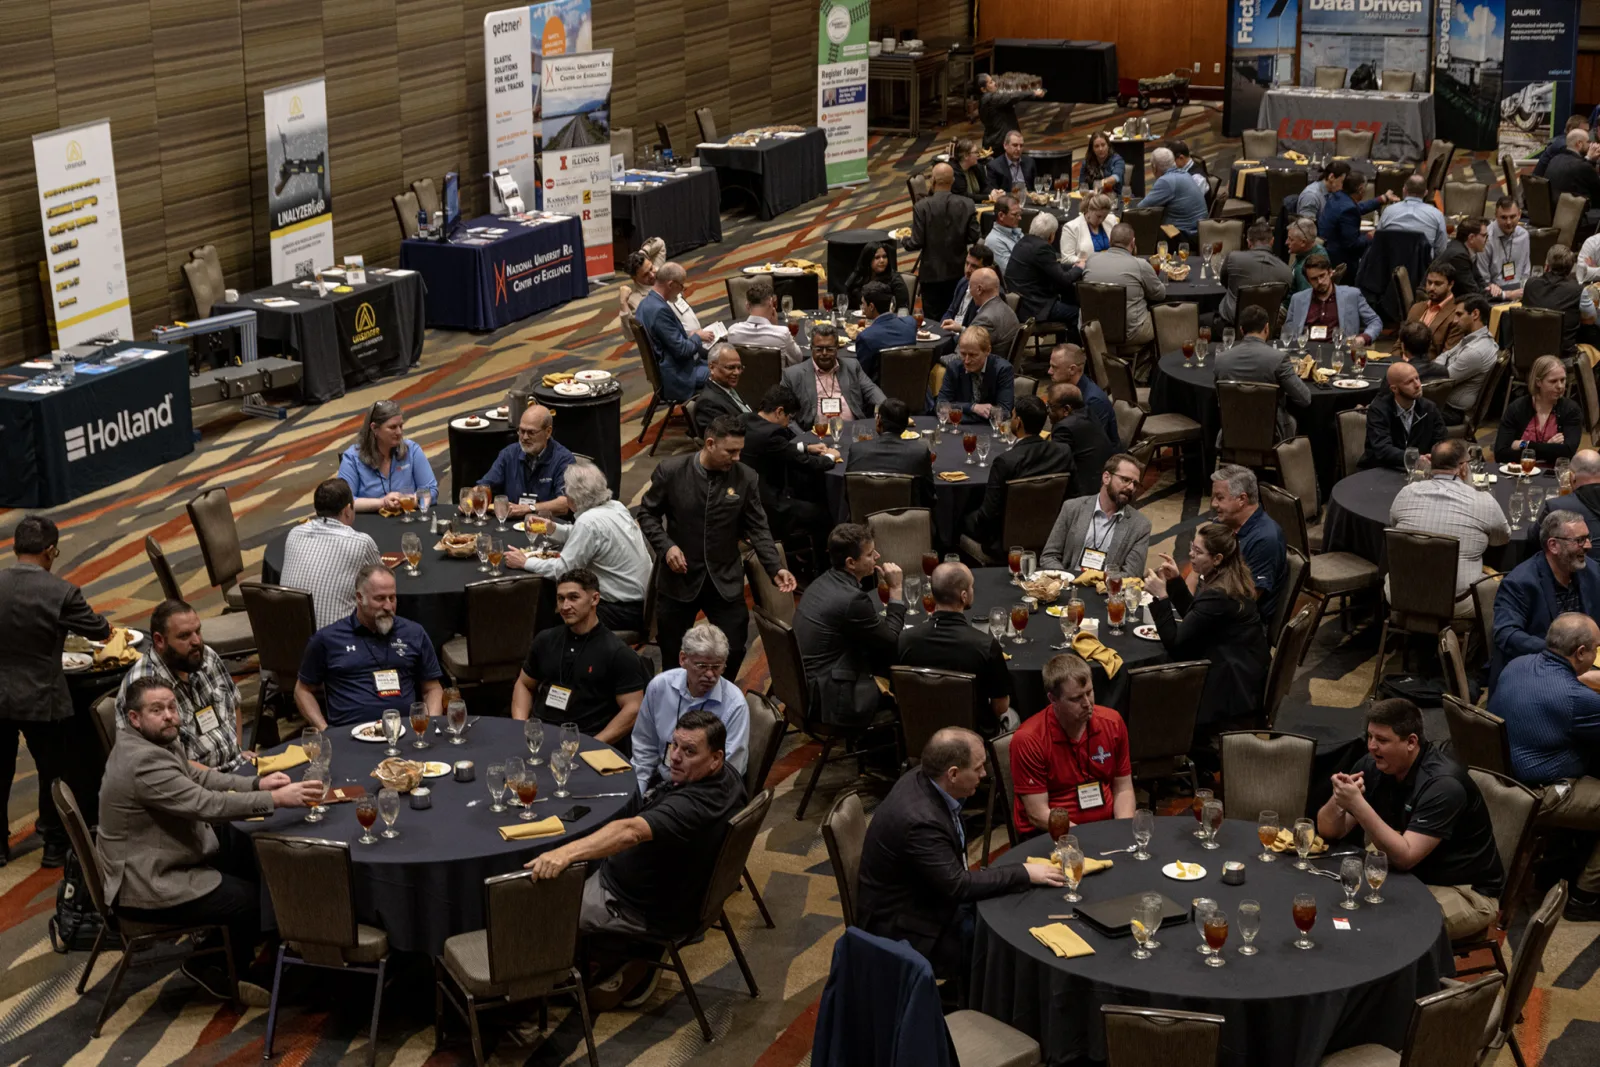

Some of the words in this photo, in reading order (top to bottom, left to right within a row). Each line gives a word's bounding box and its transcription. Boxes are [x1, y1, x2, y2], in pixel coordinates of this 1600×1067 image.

[1310, 0, 1355, 11] Data
[1359, 0, 1422, 12] Driven
[1364, 12, 1412, 20] MAINTENANCE
[493, 19, 520, 37] getzner
[494, 54, 512, 65] ELASTIC
[494, 62, 518, 75] SOLUTIONS
[822, 69, 841, 79] Register
[844, 67, 858, 76] Today
[495, 76, 504, 85] FOR
[504, 73, 518, 84] HEAVY
[495, 85, 506, 95] HAUL
[508, 81, 524, 93] TRACKS
[572, 155, 600, 165] ILLINOIS
[506, 259, 532, 277] NATIONAL
[534, 249, 561, 266] UNIVERSITY
[87, 394, 173, 455] Holland
